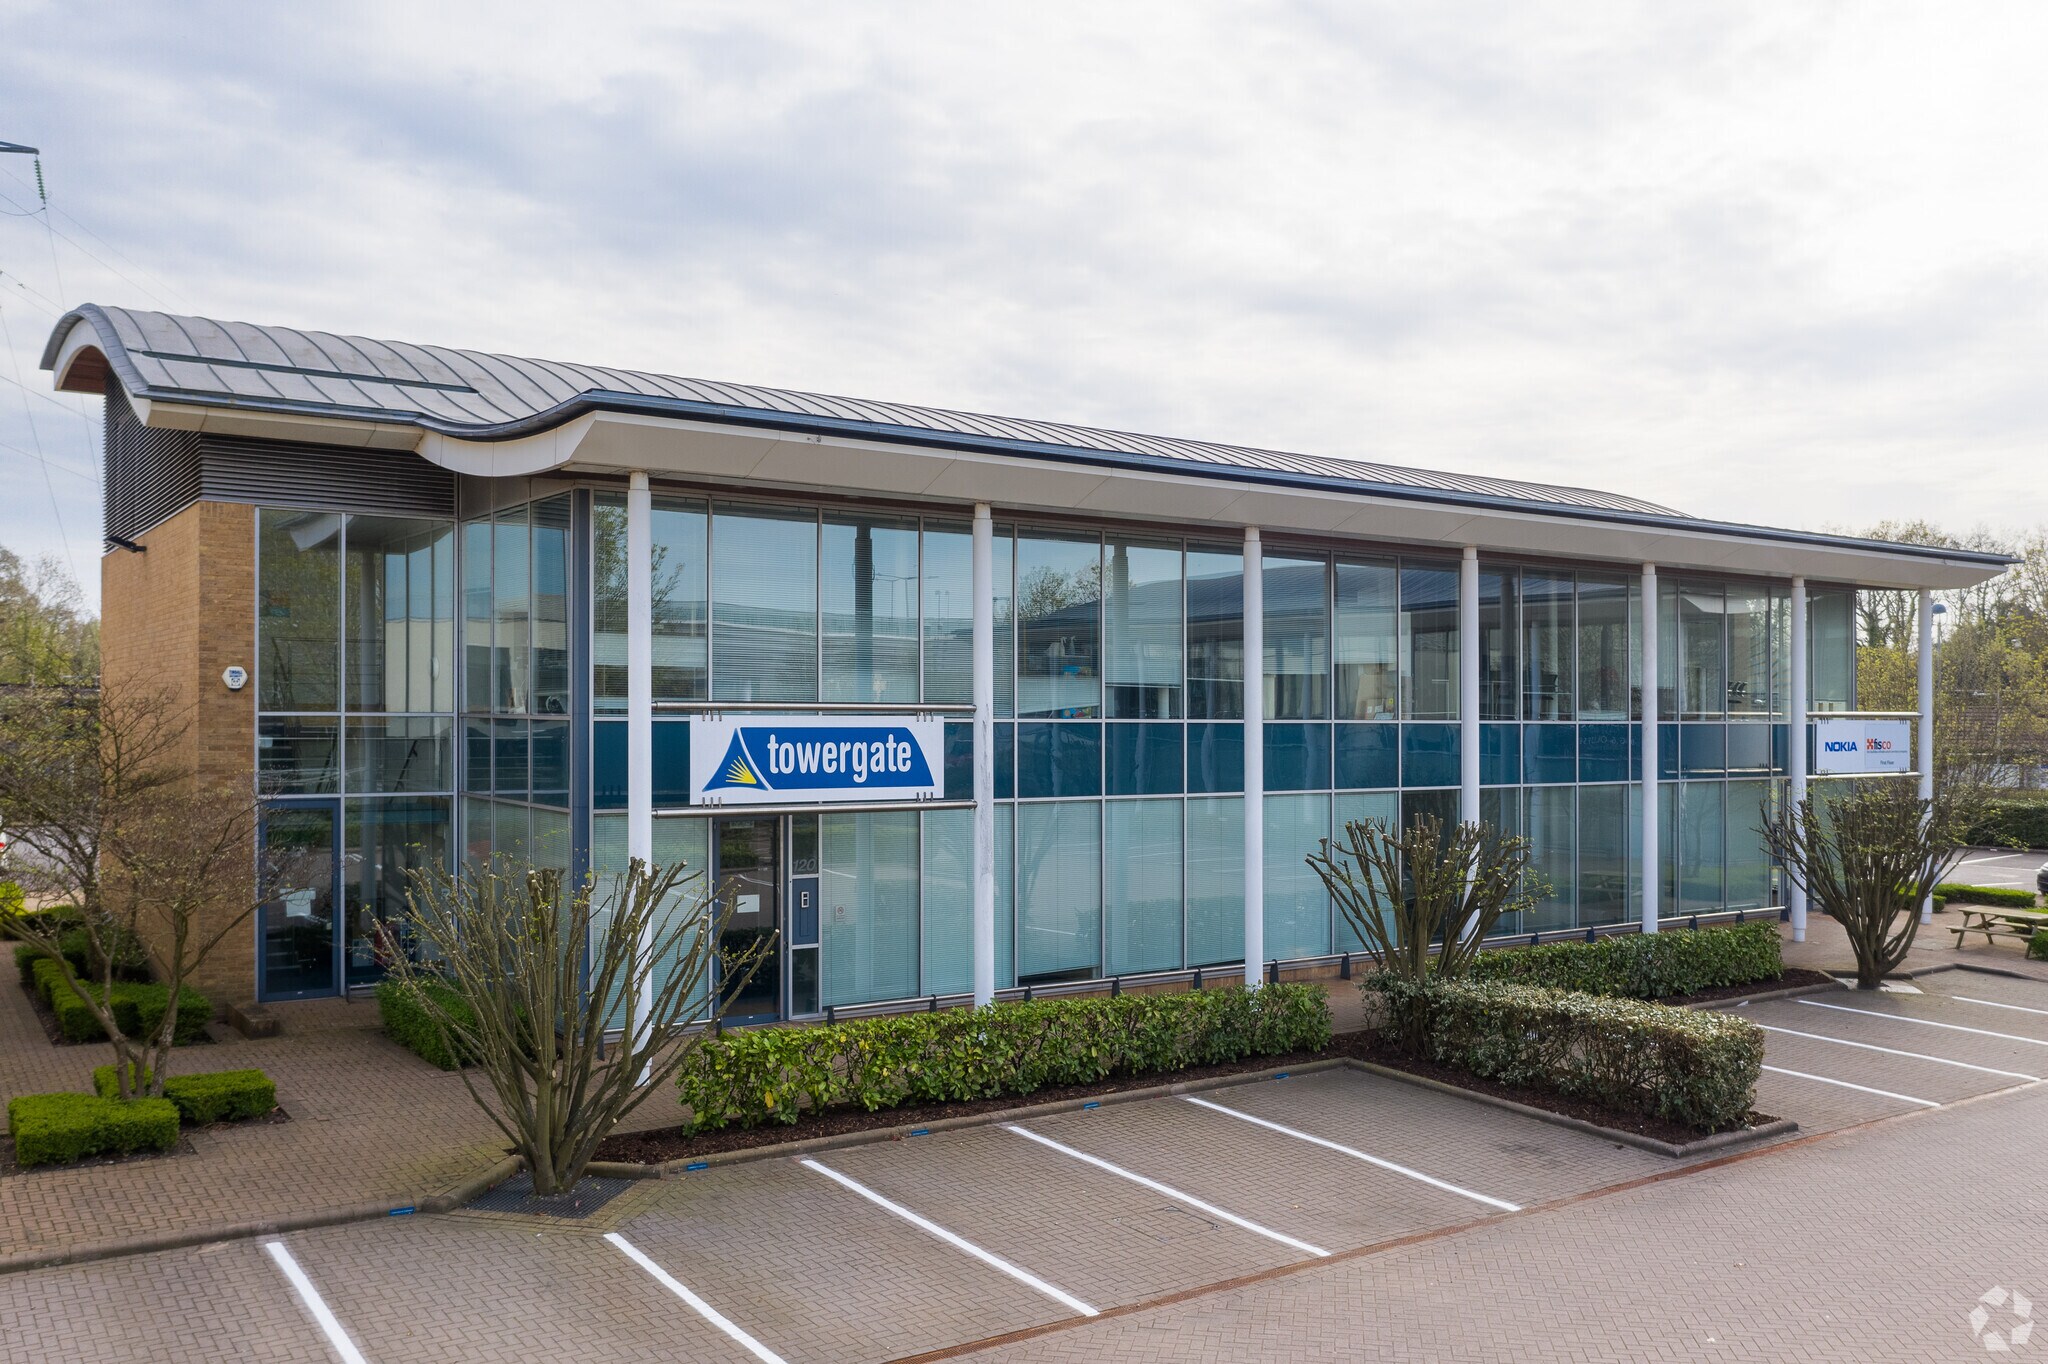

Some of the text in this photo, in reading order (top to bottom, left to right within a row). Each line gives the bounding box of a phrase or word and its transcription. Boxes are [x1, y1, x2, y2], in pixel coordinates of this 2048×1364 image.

[1825, 742, 1857, 751] NOKIA
[767, 733, 912, 783] towergate
[793, 859, 816, 871] 120
